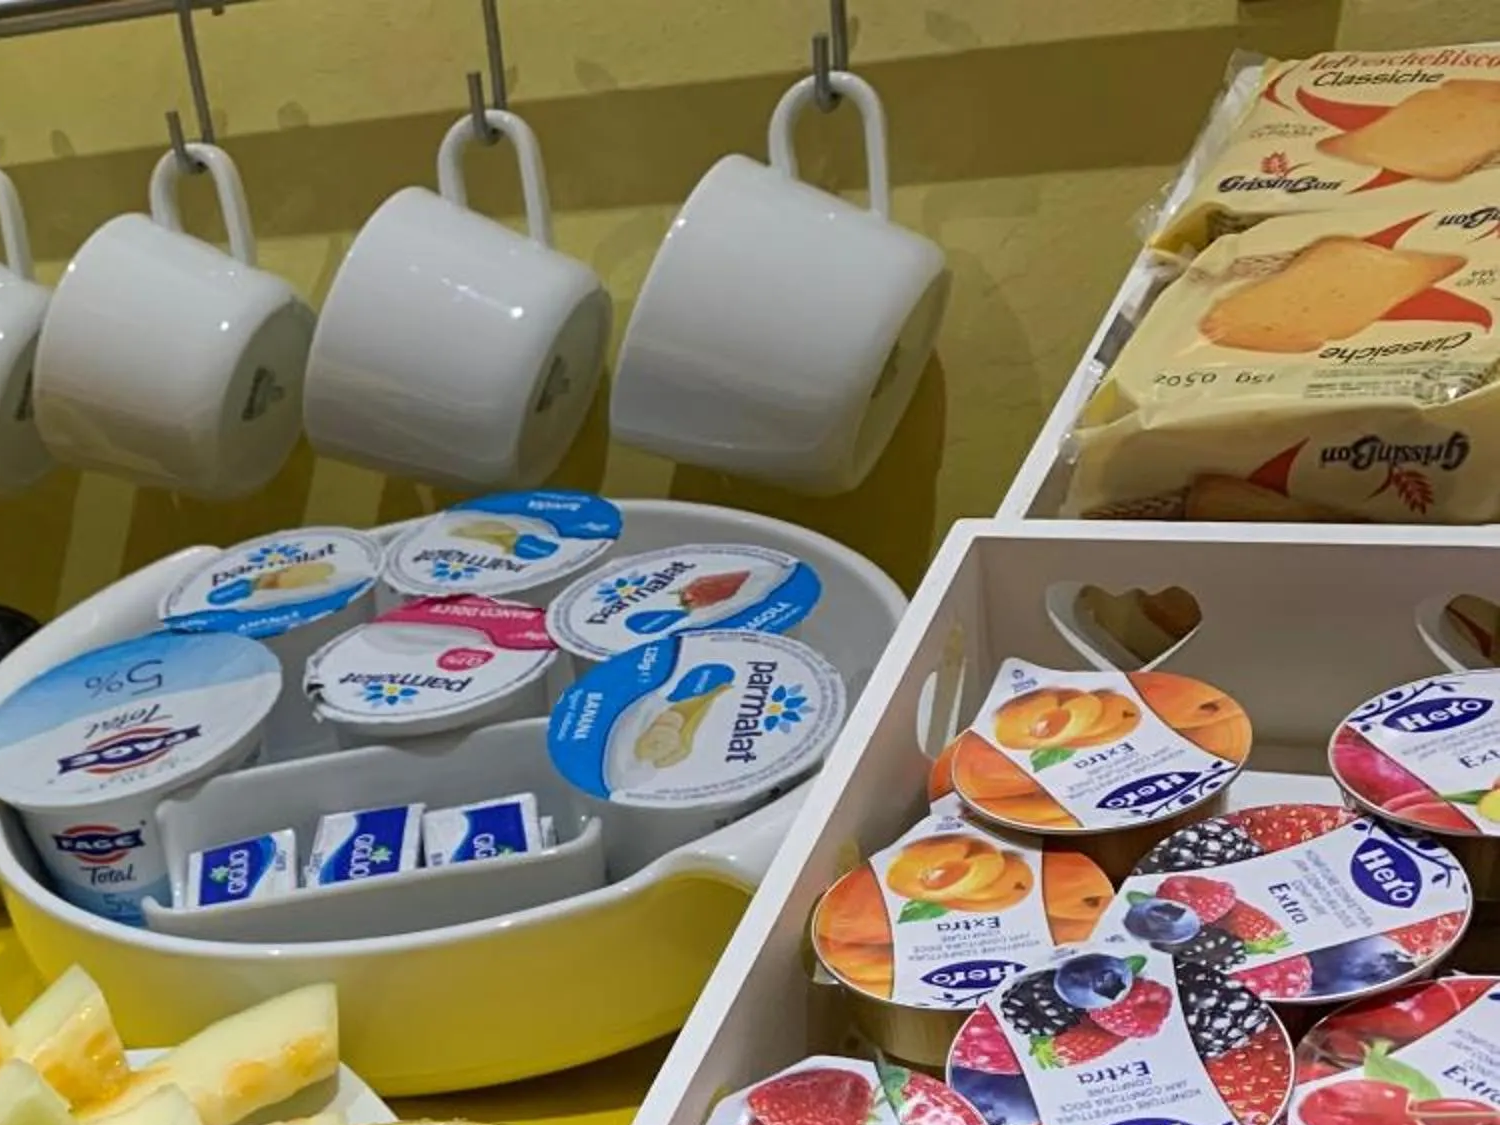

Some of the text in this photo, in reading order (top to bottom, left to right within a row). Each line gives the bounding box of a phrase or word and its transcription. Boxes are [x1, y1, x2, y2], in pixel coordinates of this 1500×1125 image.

[1313, 69, 1445, 88] Classiche
[1217, 175, 1344, 193] GrissinBon
[1319, 331, 1472, 364] Classiche
[1319, 432, 1471, 470] GrissinBon
[212, 543, 335, 587] parmalat
[412, 549, 527, 574] parmalat
[586, 560, 697, 626] parmalat
[85, 658, 165, 699] 5%
[338, 670, 474, 697] parmalat
[83, 703, 173, 739] Total
[572, 691, 604, 740] BANANA
[724, 660, 778, 764] parmalat
[1399, 697, 1485, 731] Hero
[1073, 741, 1135, 771] Extra
[1105, 774, 1186, 811] Hero
[79, 863, 137, 886] Total
[1358, 847, 1413, 902] Hero
[1268, 882, 1308, 925] Extra
[936, 915, 1000, 935] Extra
[931, 963, 1016, 986] Hero
[1075, 1059, 1149, 1088] Extra
